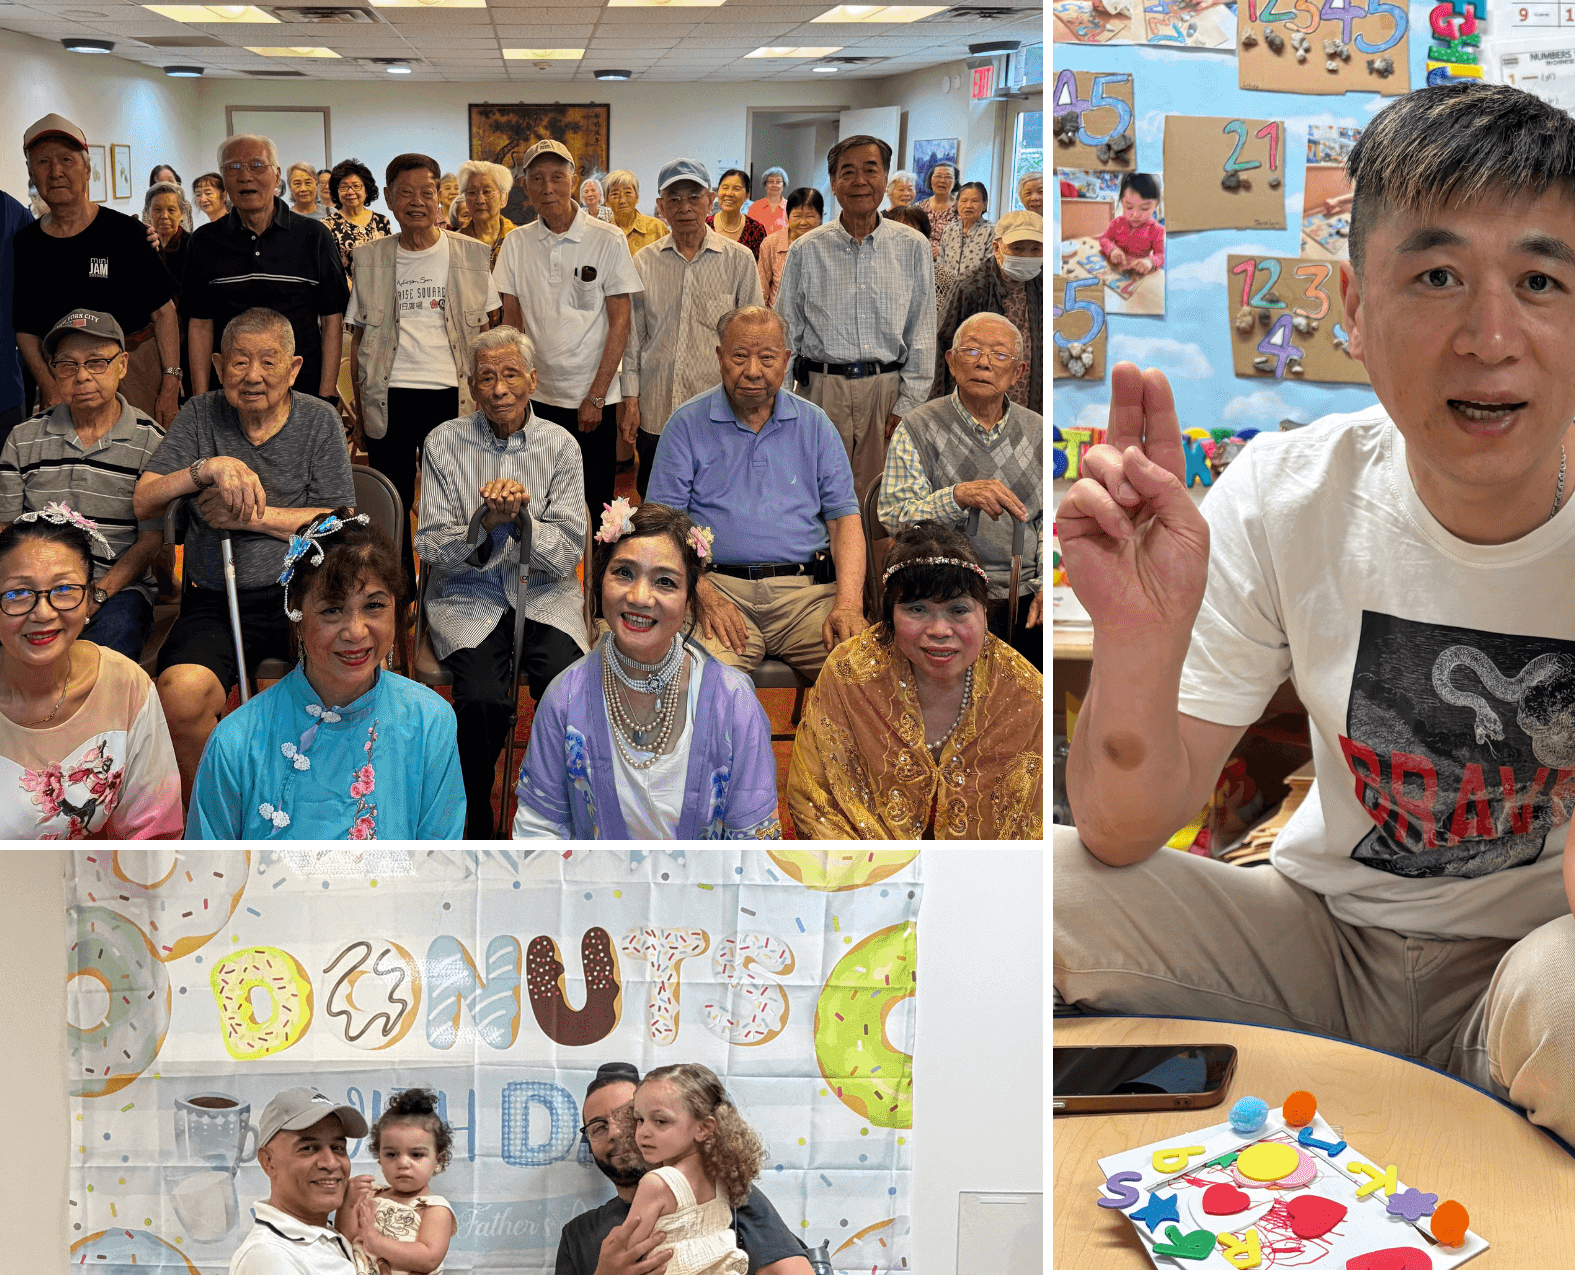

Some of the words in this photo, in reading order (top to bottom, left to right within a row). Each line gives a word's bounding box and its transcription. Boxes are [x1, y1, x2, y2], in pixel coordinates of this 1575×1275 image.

[1519, 8, 1529, 21] 9
[1530, 51, 1572, 61] NUMBERS
[1223, 120, 1281, 172] 21
[89, 263, 108, 275] JAM
[417, 287, 446, 298] SQUARE
[84, 313, 100, 323] CITY
[209, 926, 797, 1062] DONUTS
